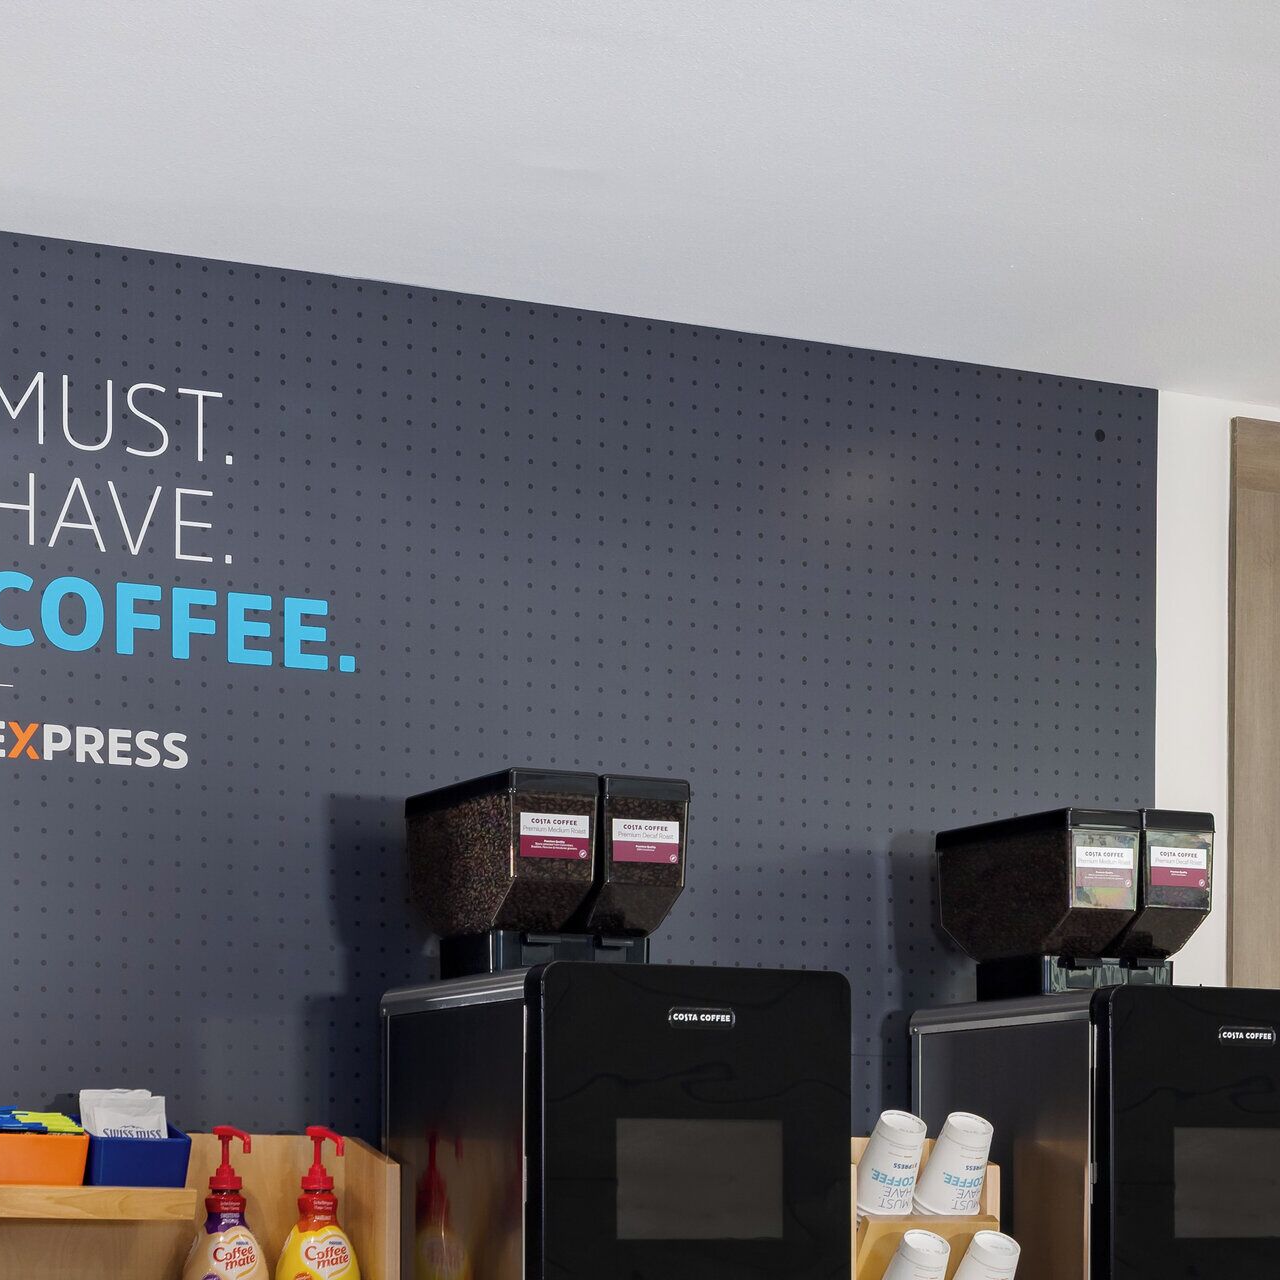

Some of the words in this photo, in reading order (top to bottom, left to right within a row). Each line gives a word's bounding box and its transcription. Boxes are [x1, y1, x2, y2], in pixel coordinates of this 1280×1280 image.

[531, 817, 551, 825] COSTA
[672, 1013, 698, 1022] COSTA
[699, 1014, 731, 1022] COFFEE
[1222, 1031, 1245, 1040] COSTA
[1245, 1032, 1272, 1040] COFFEE
[871, 1168, 915, 1187] COFFEE.
[212, 1246, 253, 1262] Coffee
[304, 1245, 347, 1261] Coffee
[225, 1254, 256, 1271] mate
[317, 1254, 349, 1269] mate
